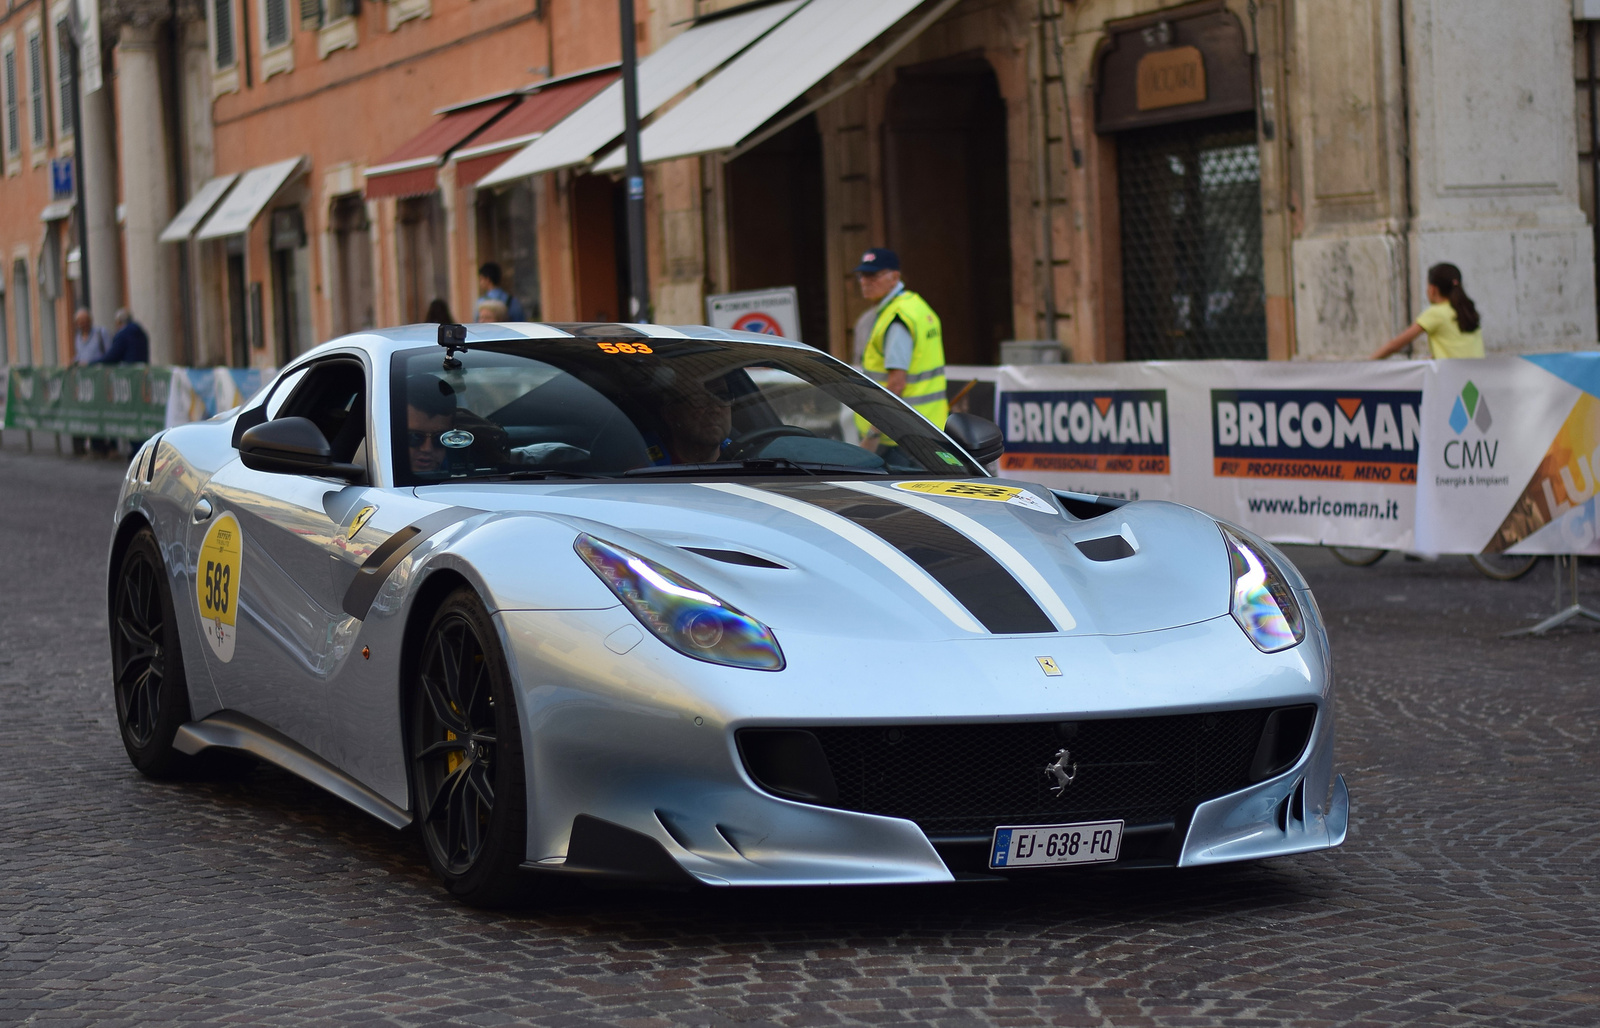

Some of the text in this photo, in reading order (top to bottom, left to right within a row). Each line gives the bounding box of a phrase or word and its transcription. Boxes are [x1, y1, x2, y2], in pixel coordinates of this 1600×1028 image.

[597, 342, 653, 354] 583
[1006, 401, 1164, 445] BRICOMAN
[1217, 401, 1420, 451] BRICOMAN
[1105, 459, 1133, 472] MENO
[1139, 459, 1165, 472] CARO
[1443, 440, 1499, 469] CMV
[1353, 465, 1392, 481] MENO
[1435, 475, 1467, 488] Energia
[1248, 495, 1399, 520] www.bricoman.it
[206, 560, 230, 614] 583
[1016, 830, 1113, 858] EJ-638-FQ
[996, 851, 1006, 864] F
